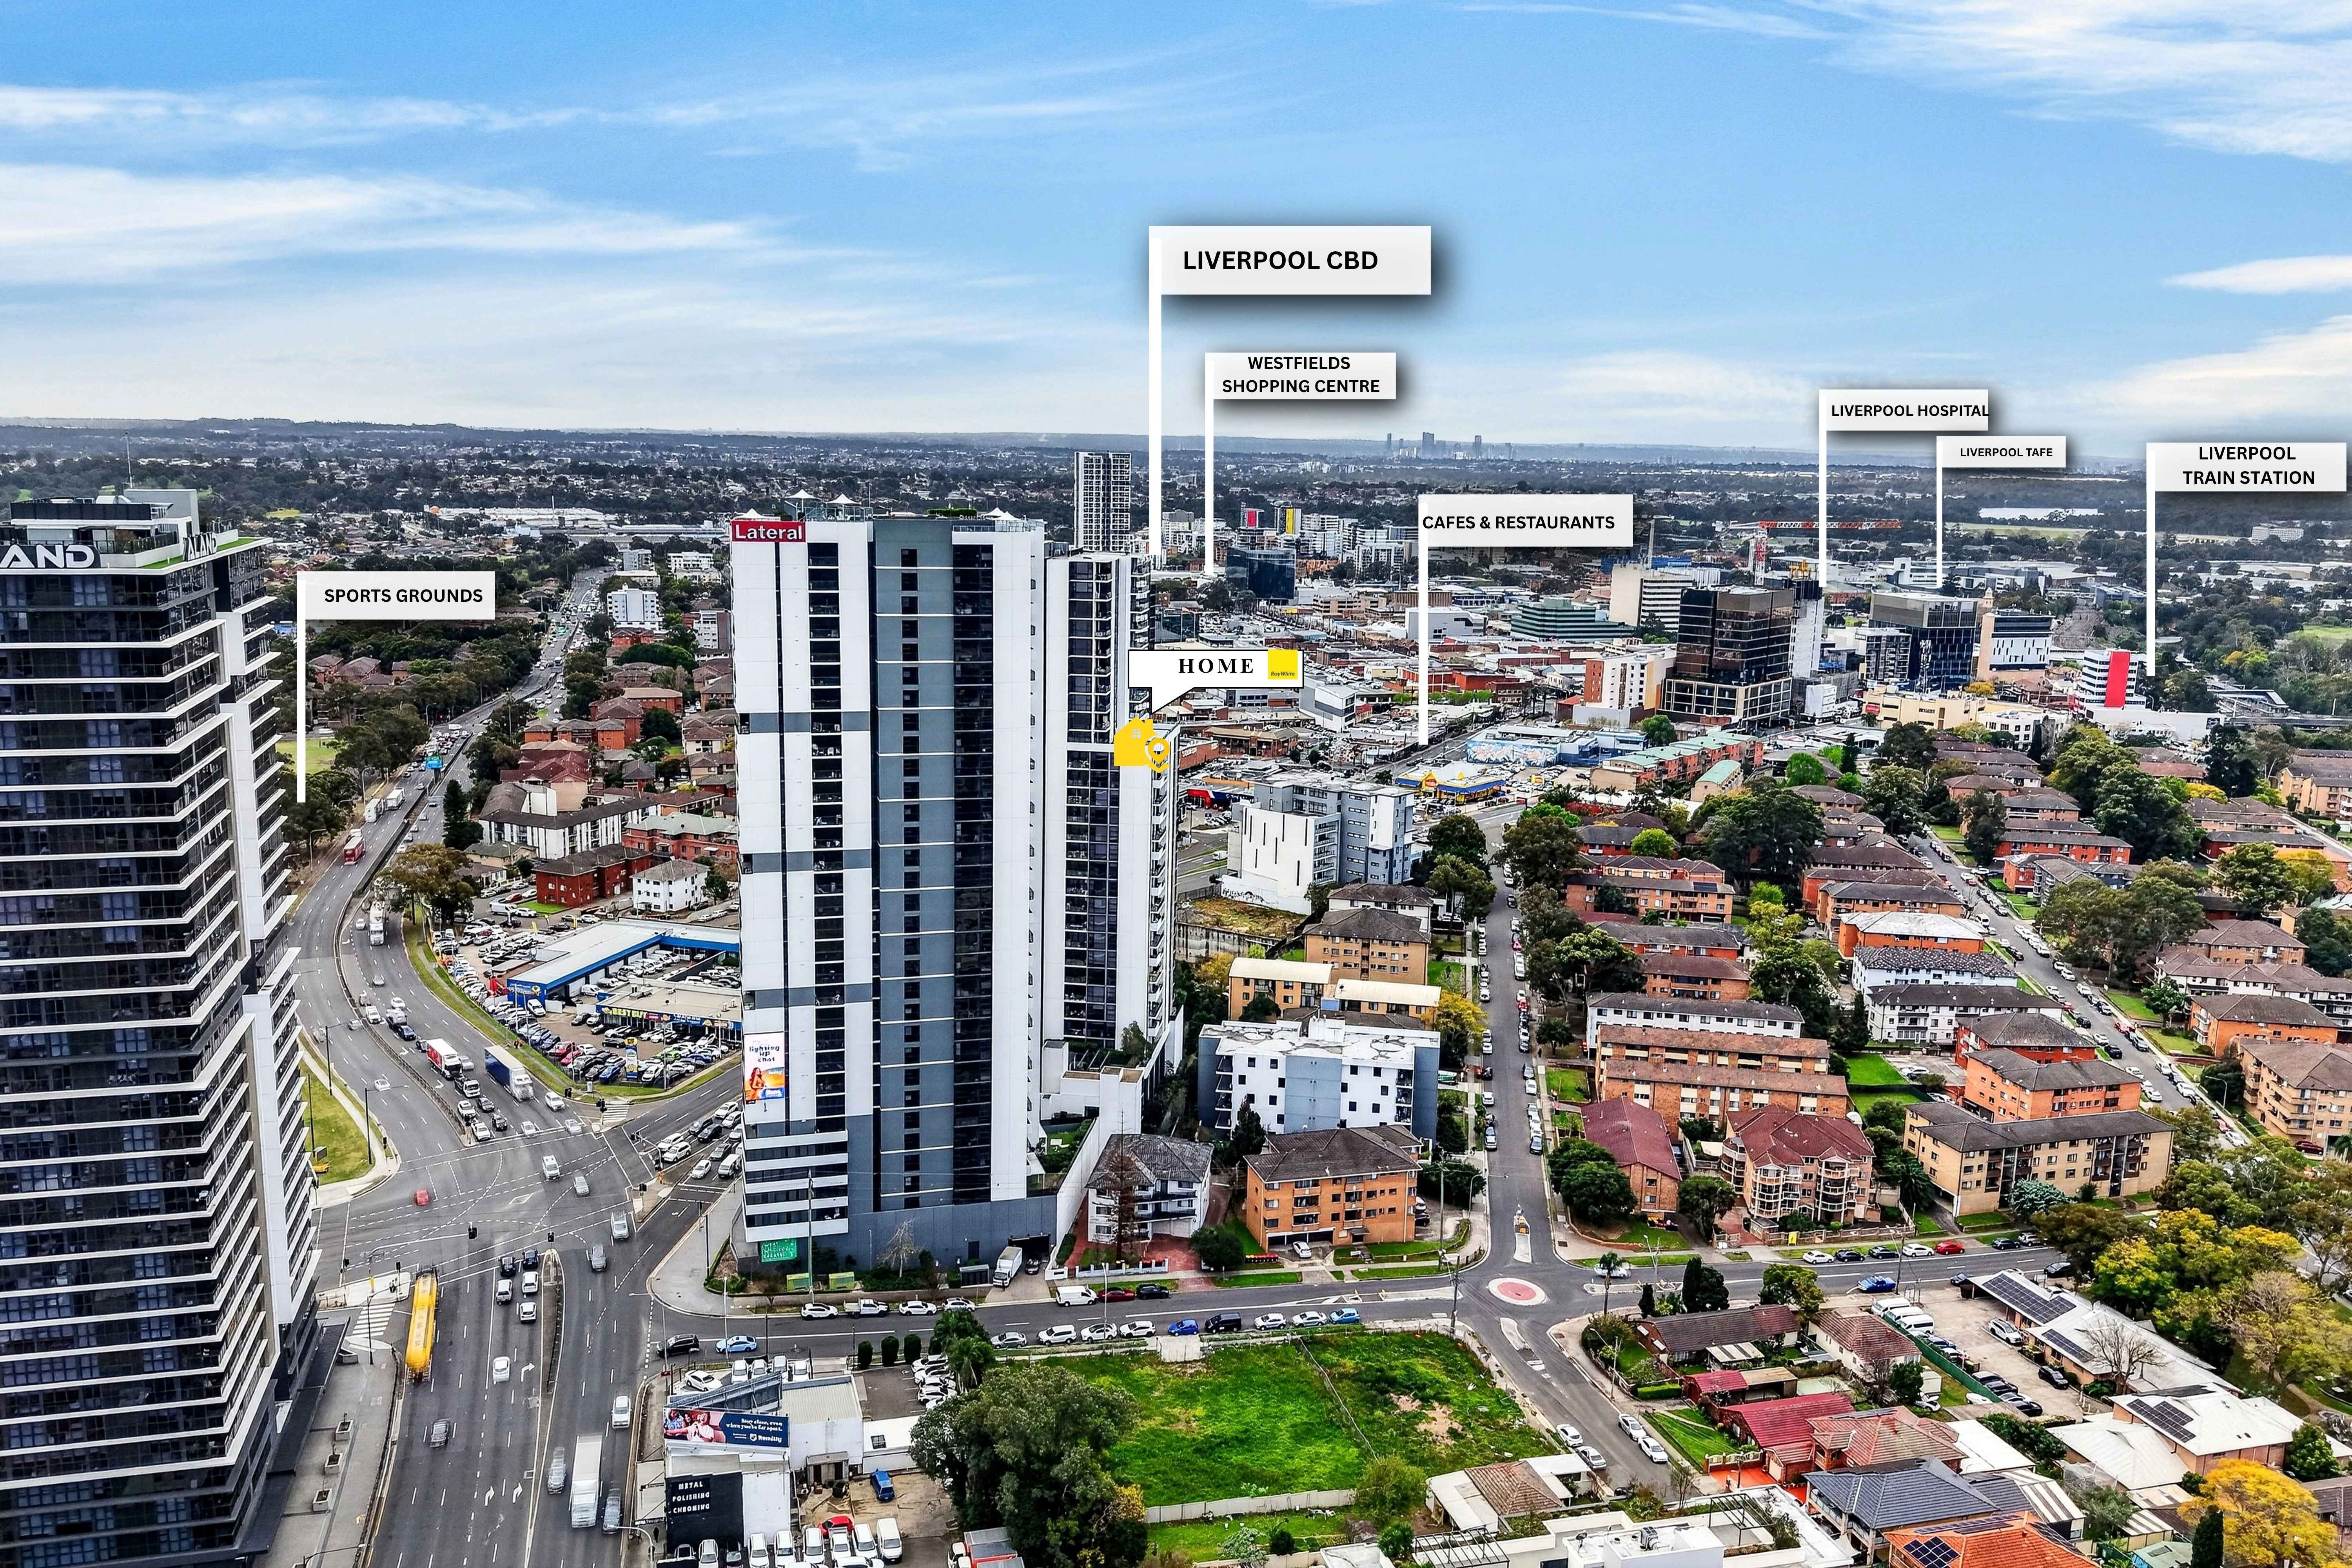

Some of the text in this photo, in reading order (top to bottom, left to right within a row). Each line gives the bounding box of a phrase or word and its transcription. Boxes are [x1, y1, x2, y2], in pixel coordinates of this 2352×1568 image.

[735, 524, 802, 539] Lateral
[678, 1481, 703, 1490] METAL
[672, 1492, 710, 1502] POLISHING
